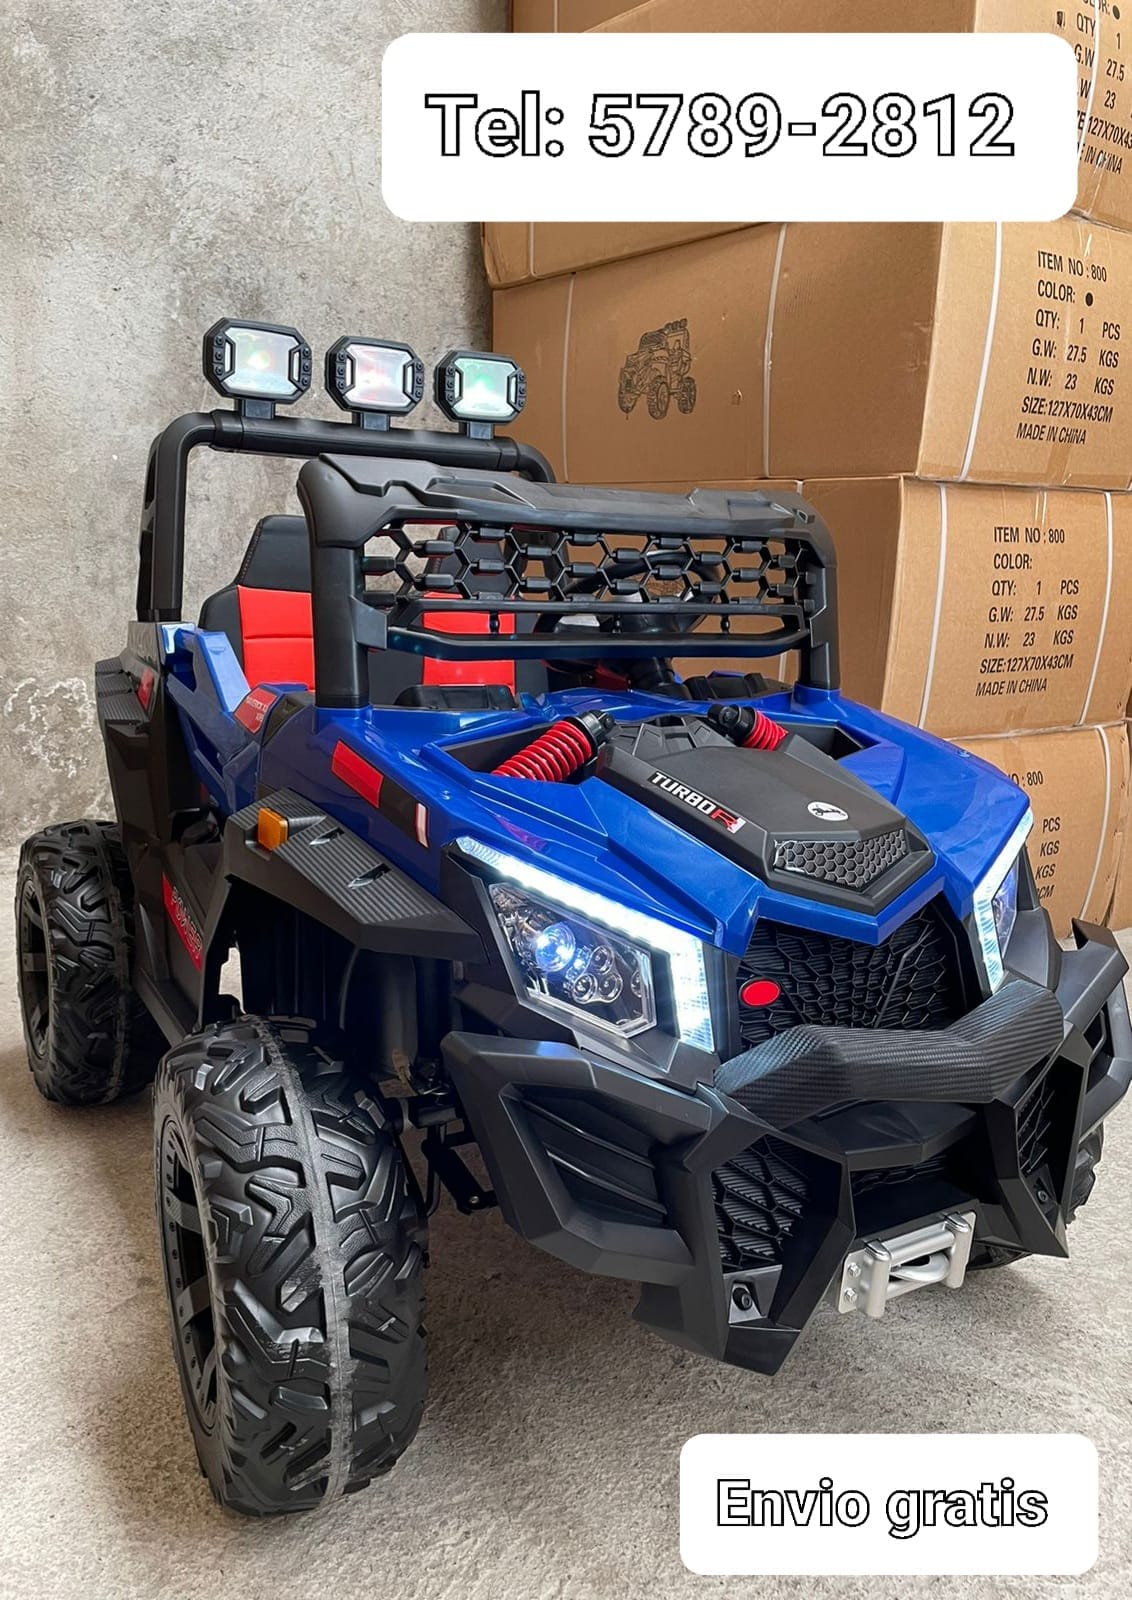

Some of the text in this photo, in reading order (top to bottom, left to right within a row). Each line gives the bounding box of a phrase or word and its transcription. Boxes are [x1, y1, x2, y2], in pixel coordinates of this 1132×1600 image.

[1116, 32, 1121, 50] 1
[1106, 58, 1125, 82] 27.5
[1104, 89, 1116, 109] 23
[1037, 250, 1063, 273] ITEM
[1037, 279, 1076, 303] COLOR:
[1035, 308, 1121, 341] QTY: 1 PCS
[1032, 338, 1119, 369] G.W: 27.5 KGS
[1026, 367, 1114, 396] N.W: 23 KGS
[1021, 396, 1114, 424] SIZE:127X70X43CM
[1016, 422, 1087, 445] MADE IN CHINA
[993, 526, 1020, 543] ITEM
[993, 553, 1033, 570] COLOR:
[991, 579, 1080, 596] QTY: 1 PCS
[988, 605, 1078, 623] G.W: 27.5 KGS
[984, 630, 1074, 649] N.W: 23 KGS
[979, 653, 1074, 674] SIZE:127X70X43CM
[975, 677, 1048, 697] MADE IN CHINA
[1042, 816, 1061, 833] PCS
[1039, 840, 1060, 857] KGS
[1035, 863, 1056, 880] KGS
